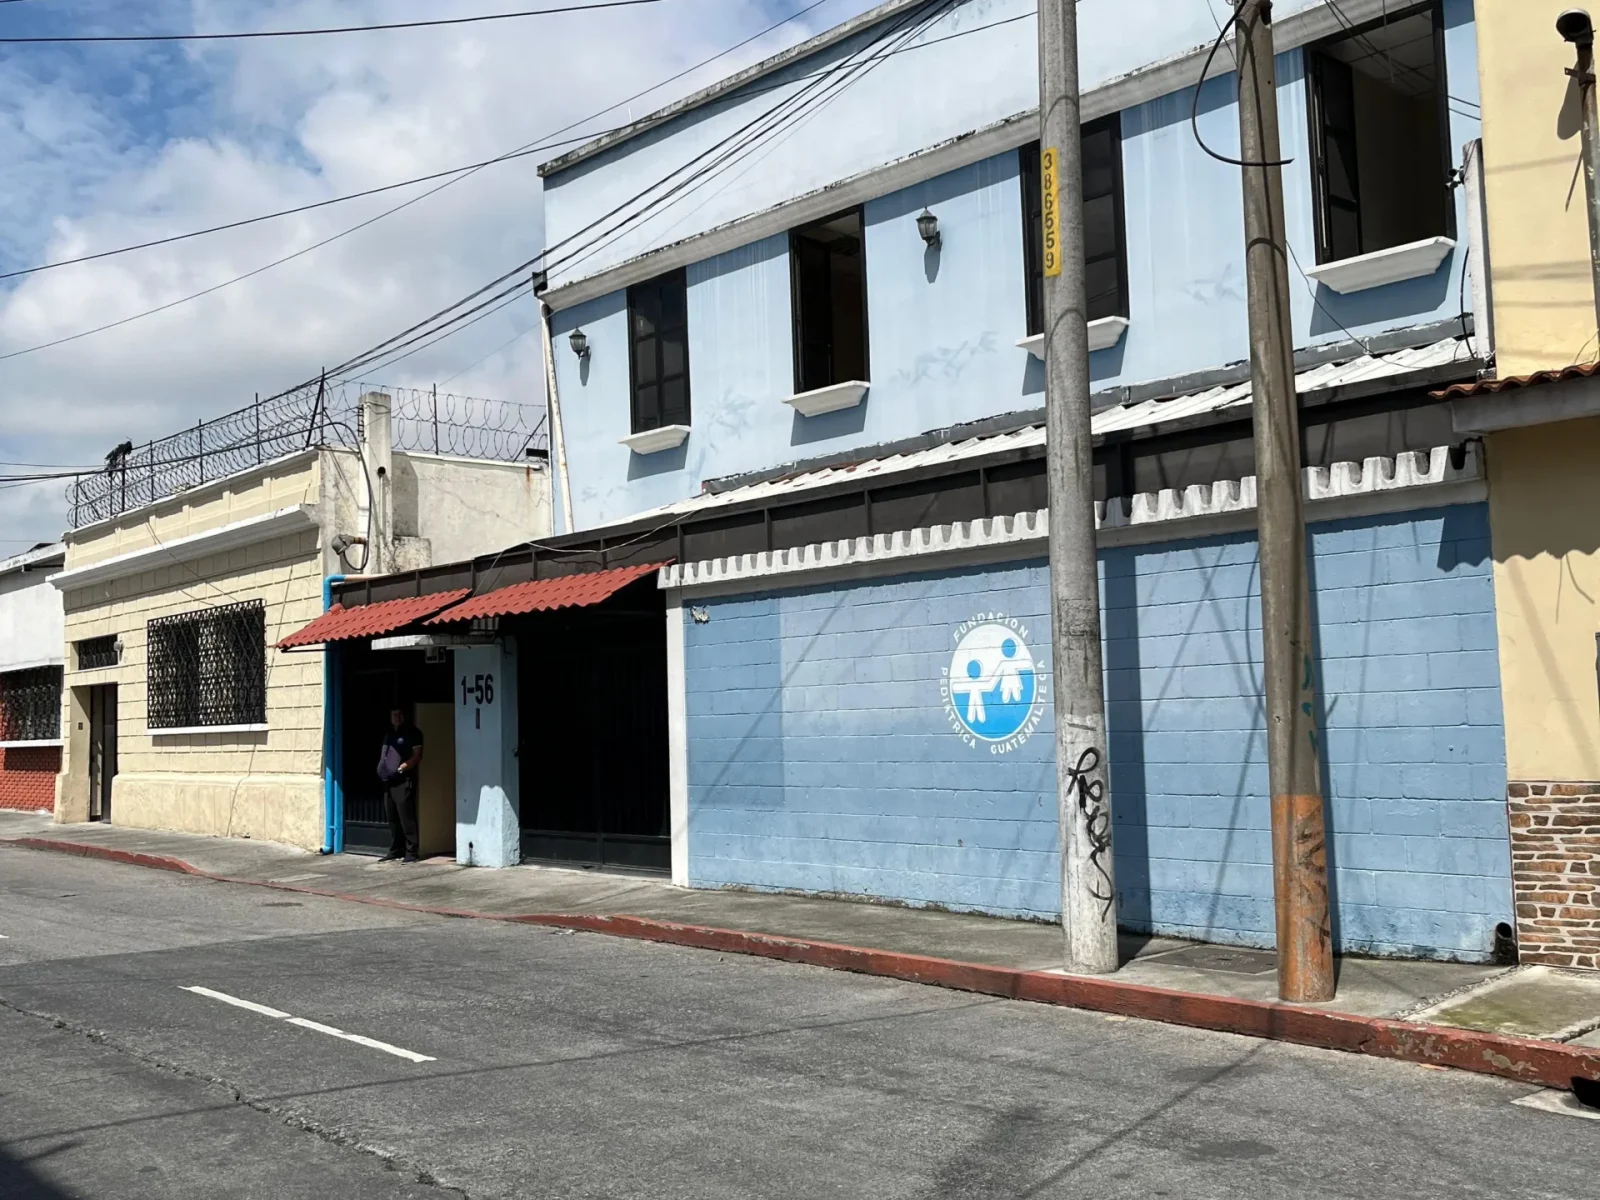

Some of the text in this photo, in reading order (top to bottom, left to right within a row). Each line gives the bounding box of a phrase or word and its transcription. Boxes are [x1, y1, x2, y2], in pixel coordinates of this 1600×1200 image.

[1043, 152, 1055, 270] 386559
[953, 611, 1029, 643] FUNDACION
[460, 673, 494, 706] 1-56
[939, 659, 1048, 755] PEDIATRICA GUATEMALTECA
